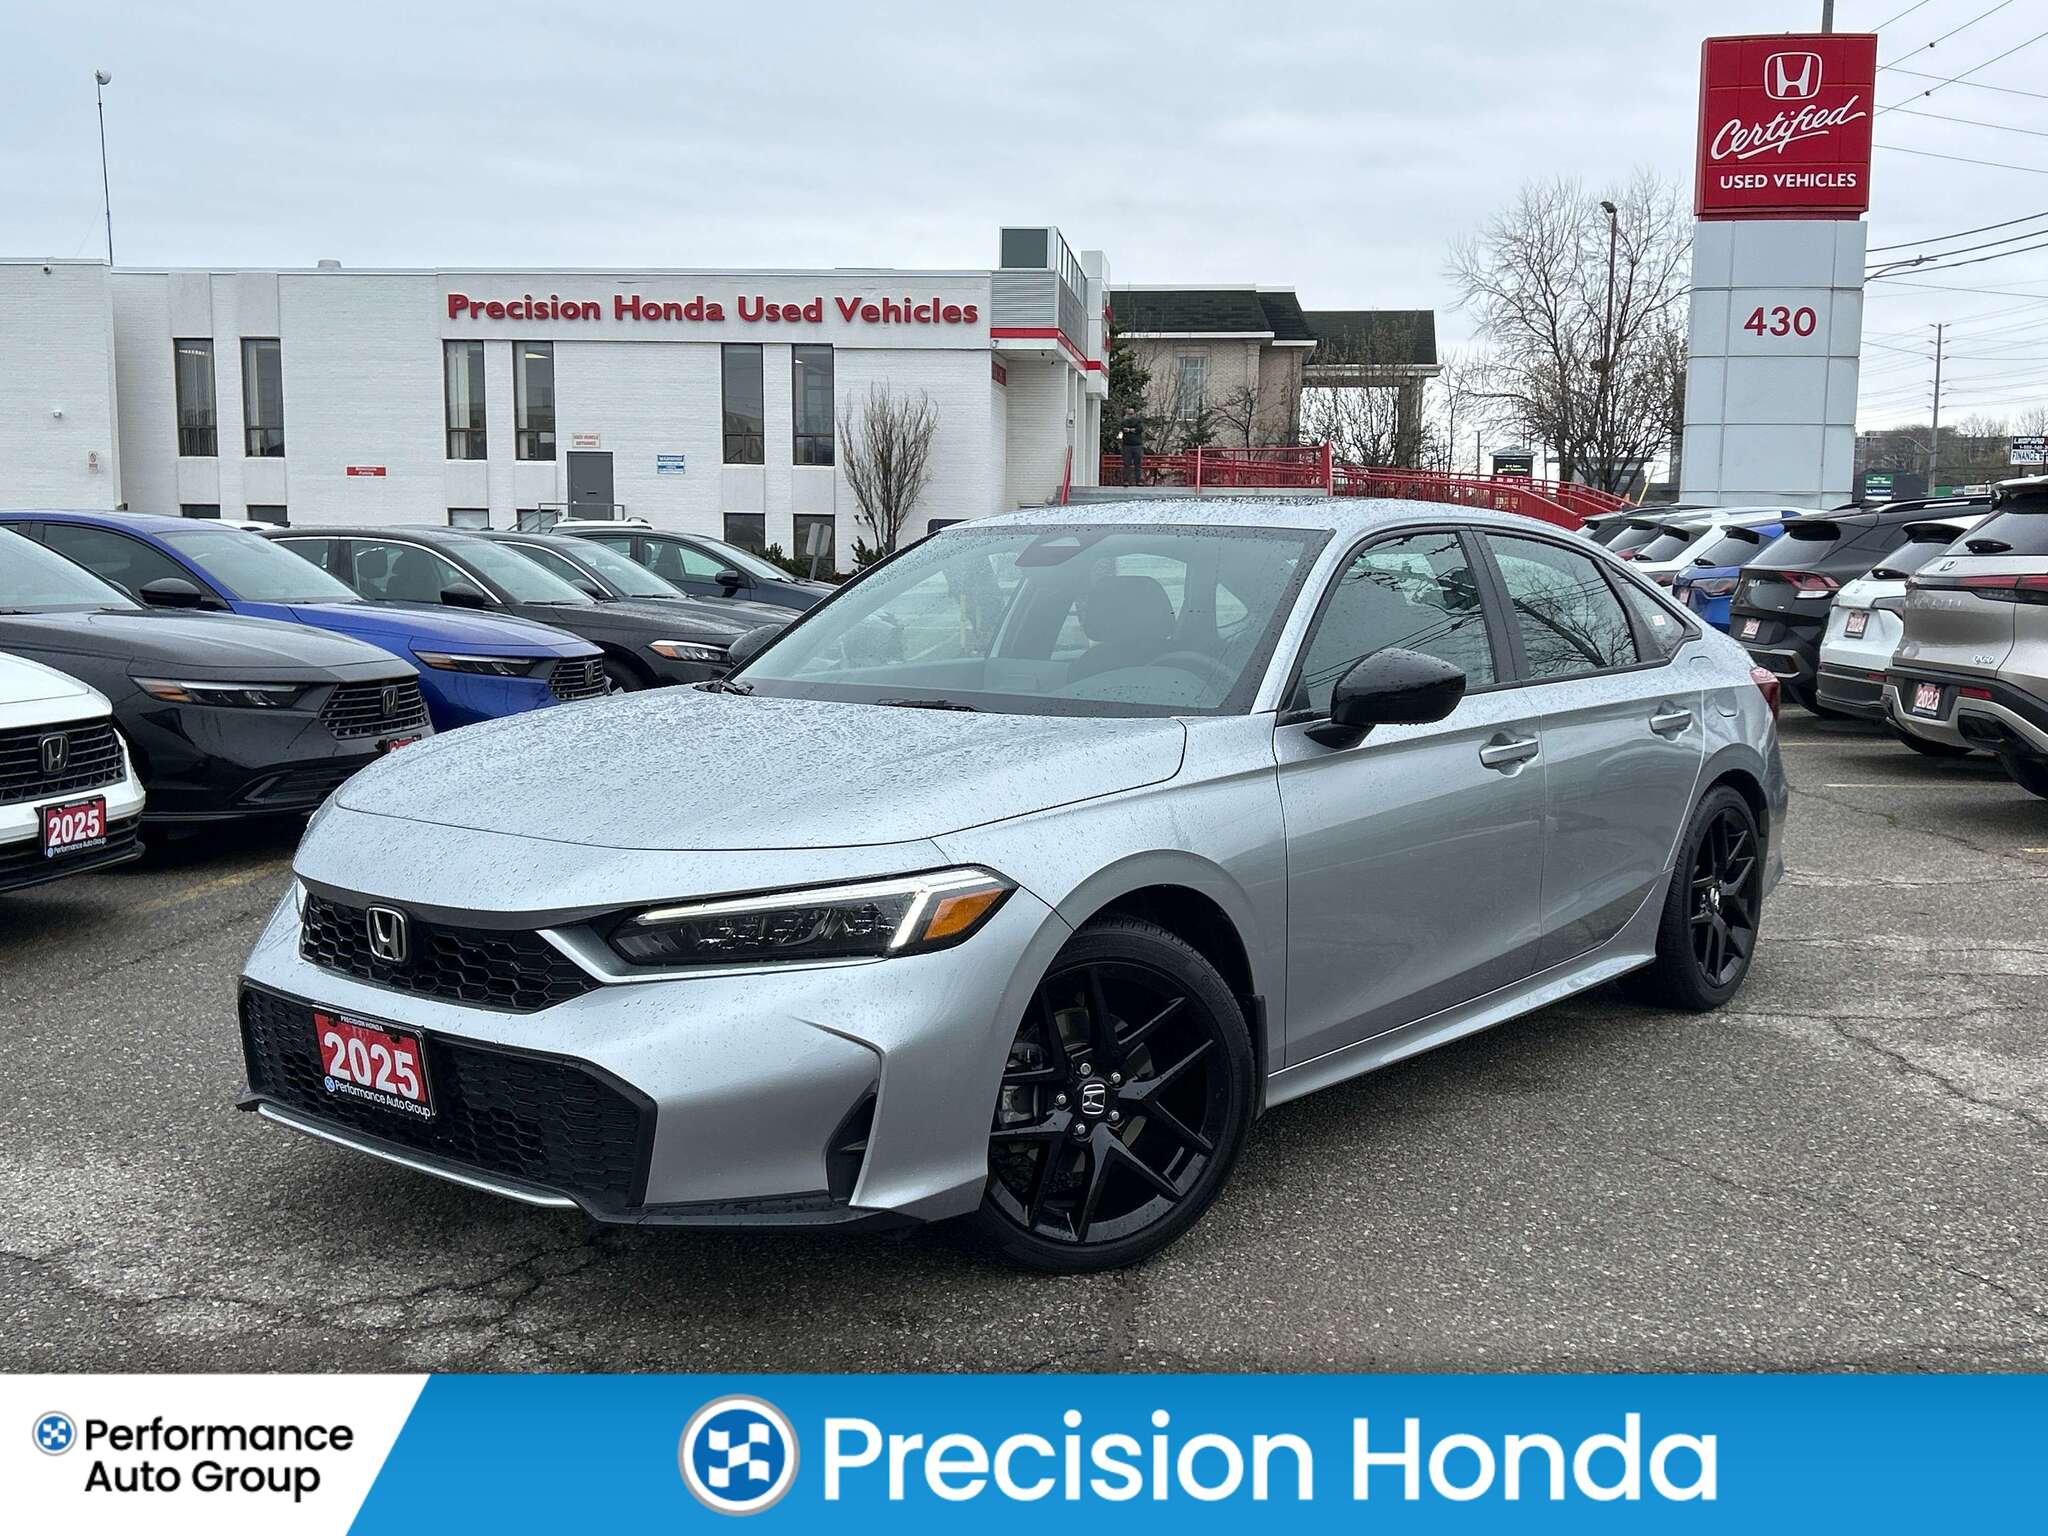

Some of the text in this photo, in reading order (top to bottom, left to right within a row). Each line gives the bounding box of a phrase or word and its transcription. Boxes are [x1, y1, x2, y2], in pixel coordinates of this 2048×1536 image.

[1711, 95, 1866, 160] Certified
[1720, 173, 1857, 189] USED VEHICLES
[448, 294, 979, 324] Precision Honda Used Vehicles
[1743, 306, 1817, 337] 430
[1916, 690, 1940, 710] 2023
[48, 809, 100, 847] 2025
[323, 1032, 419, 1100] 2025
[335, 1080, 431, 1119] Performance Auto Group
